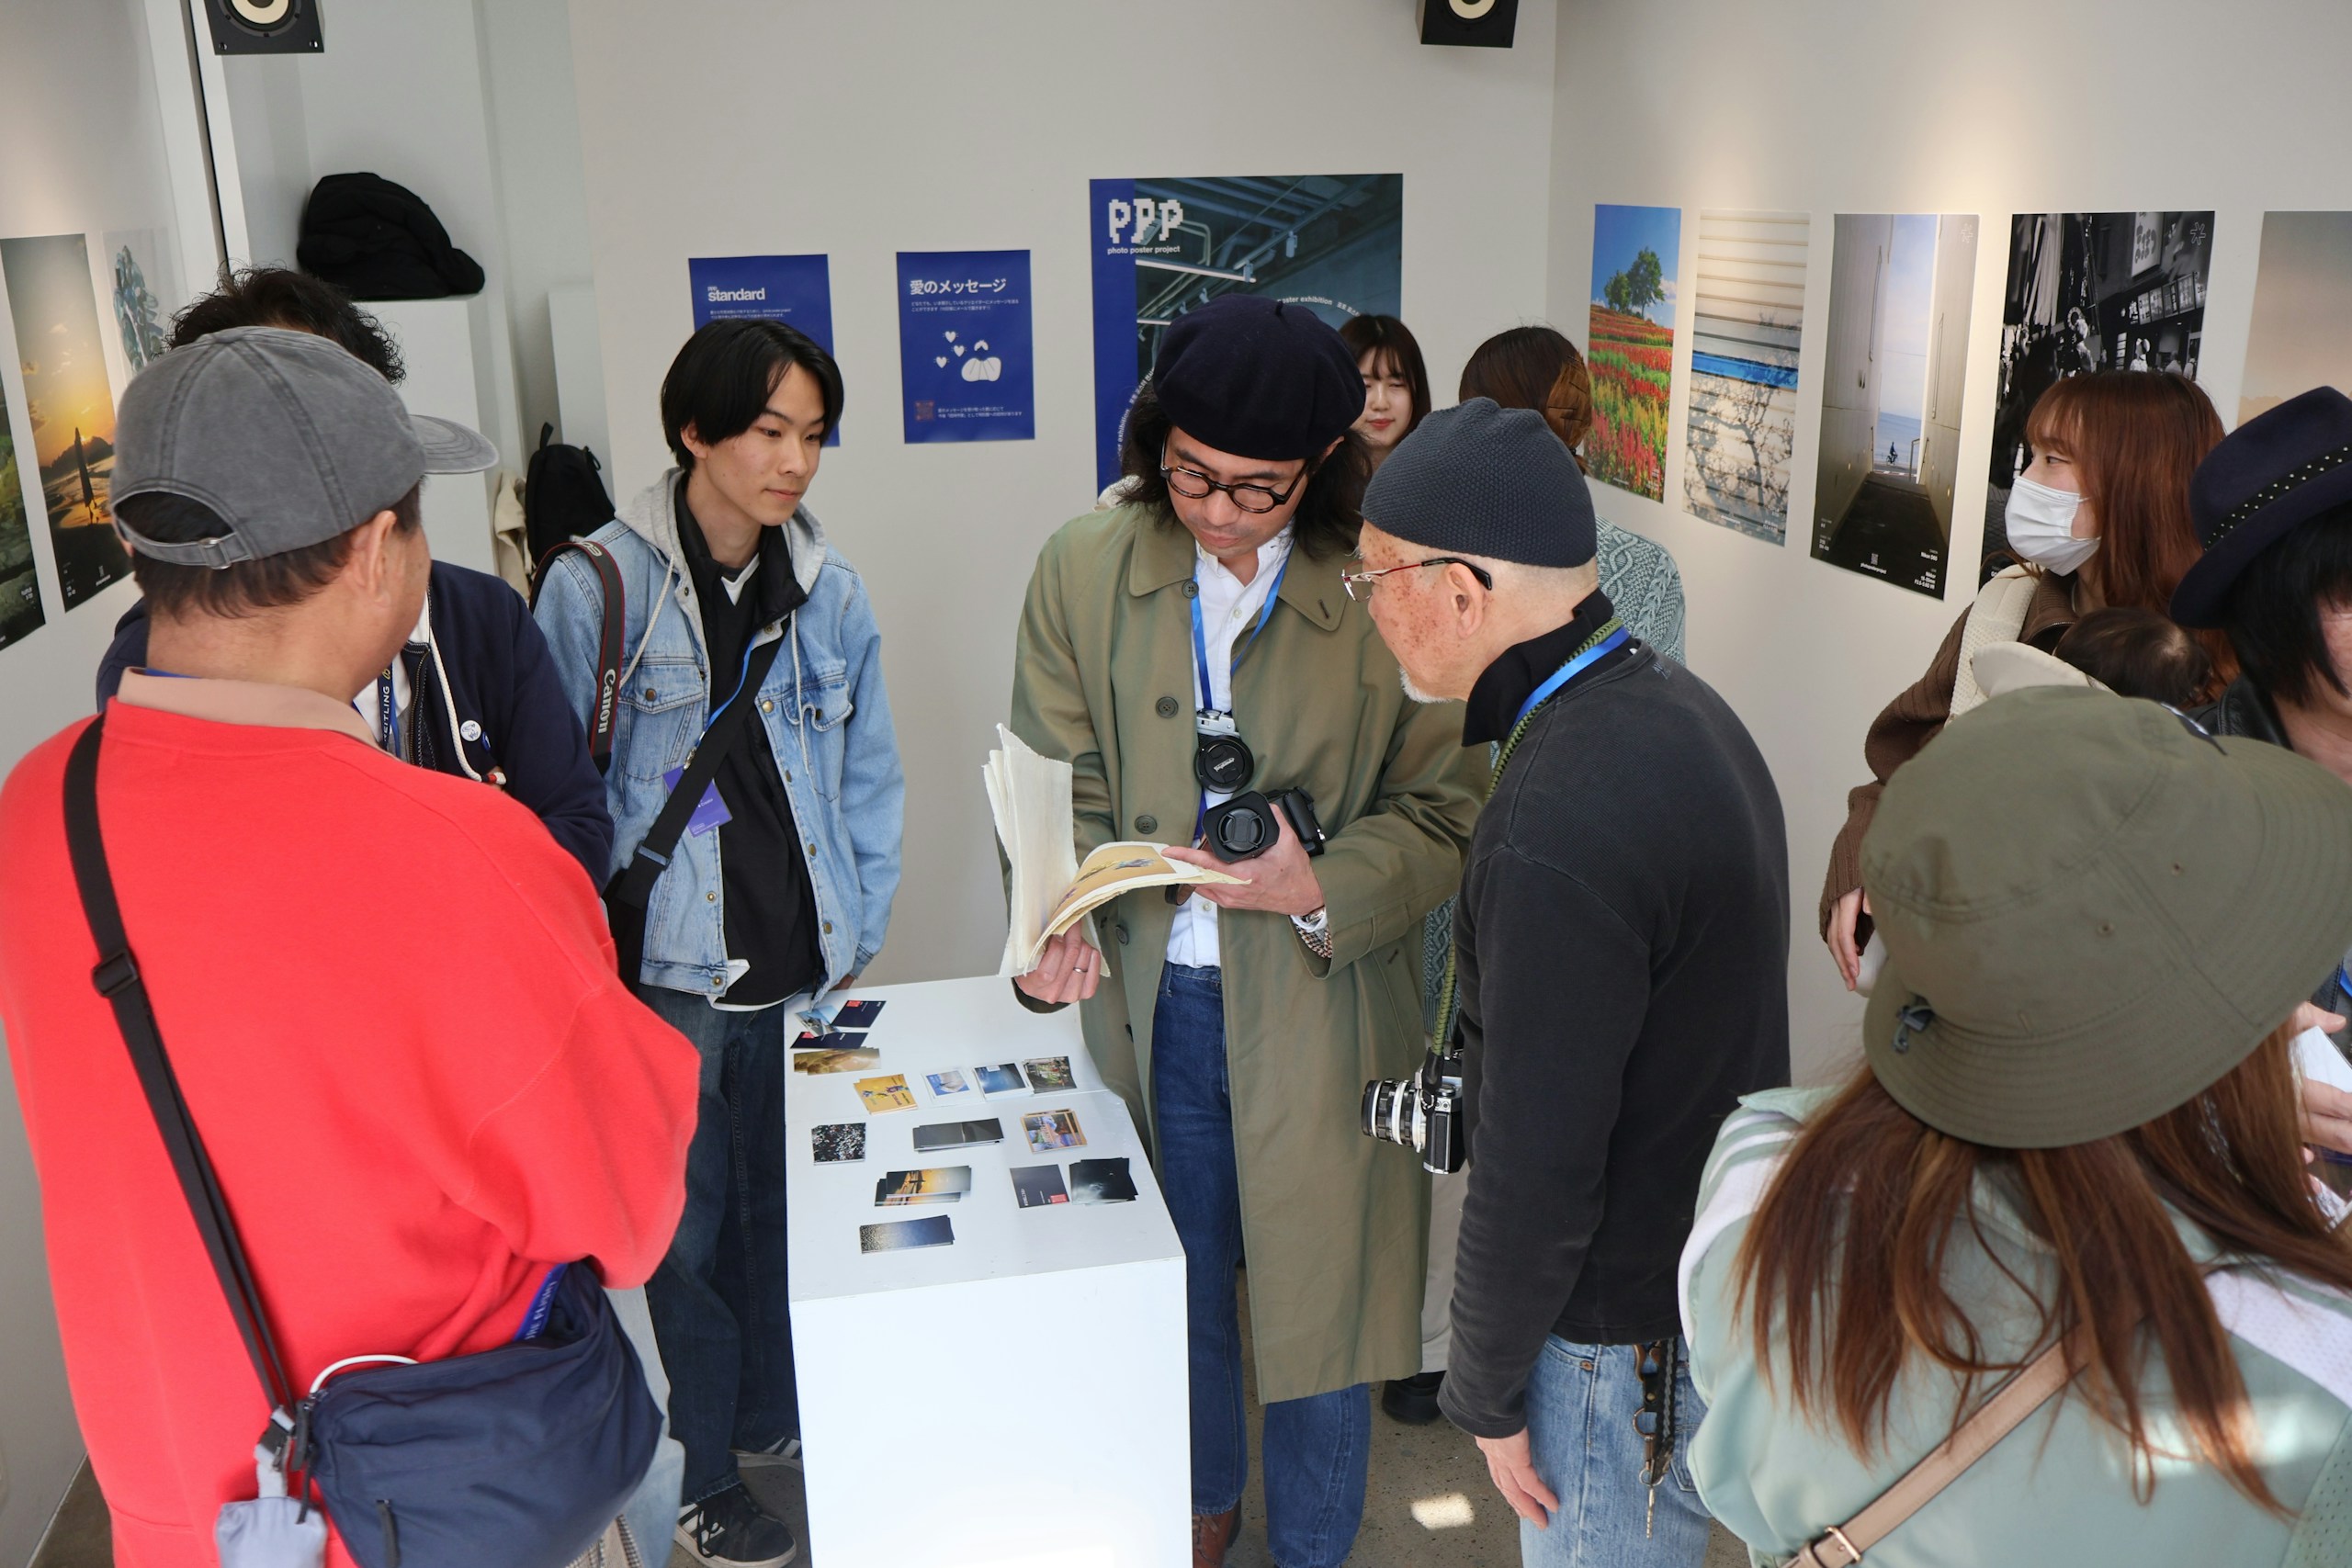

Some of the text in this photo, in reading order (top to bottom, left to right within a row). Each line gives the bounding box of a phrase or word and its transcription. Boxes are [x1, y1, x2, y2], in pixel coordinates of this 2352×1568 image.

[1107, 245, 1181, 255] photo poster project
[910, 278, 1007, 295] 愛のメッセージ
[707, 288, 765, 301] standard
[1300, 296, 1332, 305] exhibition
[598, 669, 616, 734] Canon
